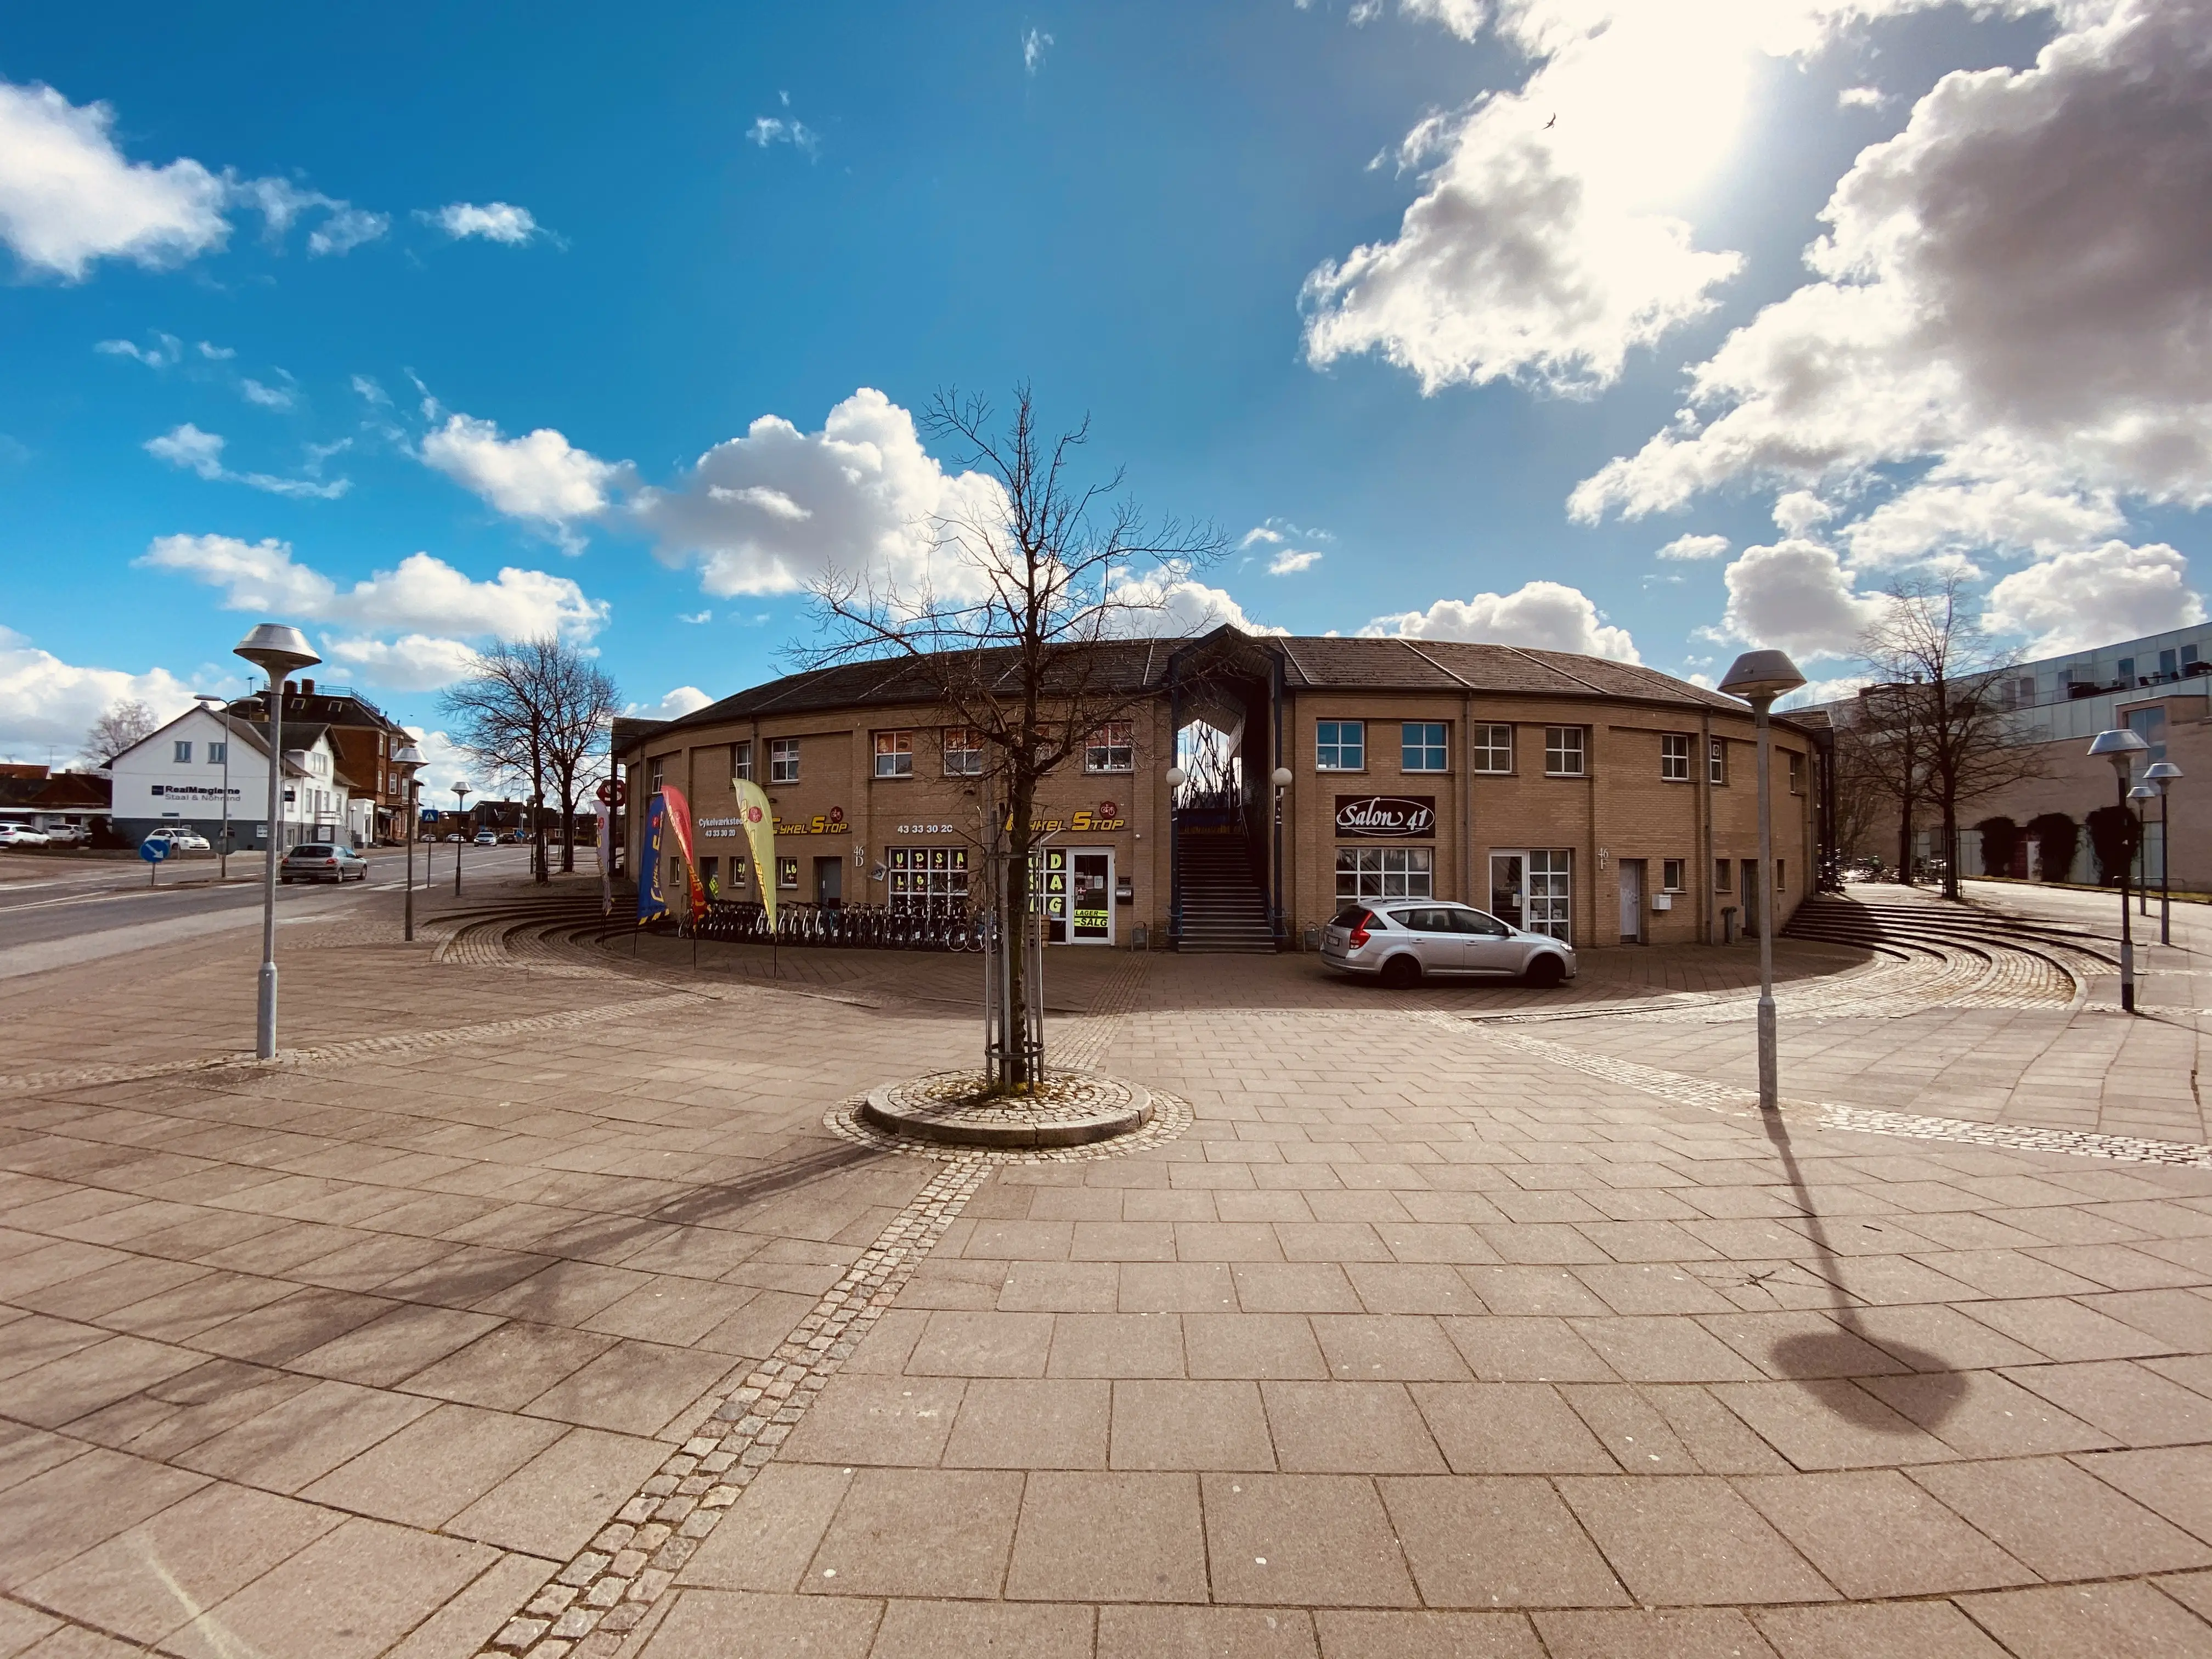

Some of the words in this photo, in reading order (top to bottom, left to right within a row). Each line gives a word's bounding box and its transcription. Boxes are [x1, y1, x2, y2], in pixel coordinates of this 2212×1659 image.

[165, 786, 240, 795] RealMæglene
[1336, 797, 1403, 826] Salon
[1406, 808, 1427, 831] 41
[811, 816, 848, 833] STOP
[1071, 811, 1125, 831] STOP
[898, 825, 909, 833] 43
[912, 825, 924, 833] 33
[927, 825, 938, 833] 30
[941, 825, 953, 833] 20
[854, 845, 864, 856] 46
[1598, 848, 1609, 858] 46
[855, 856, 864, 867] D
[1600, 858, 1609, 870] F
[1080, 918, 1108, 926] SALG
